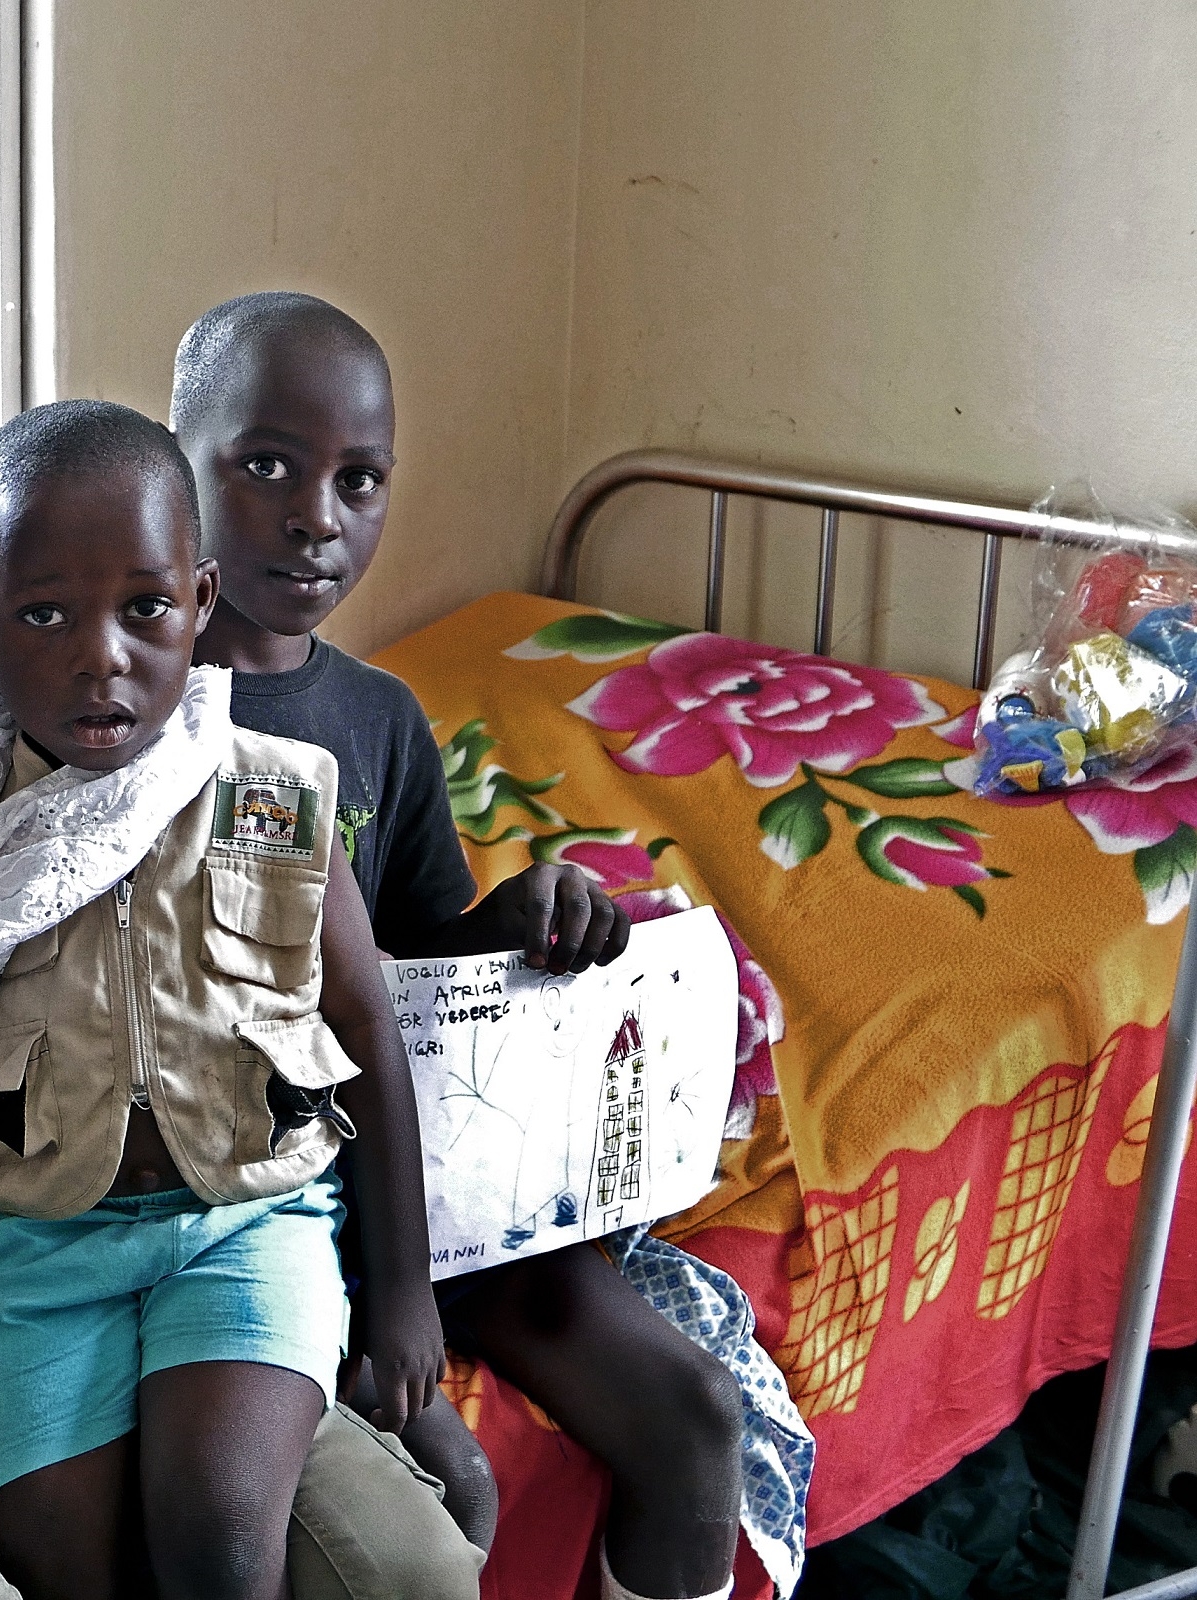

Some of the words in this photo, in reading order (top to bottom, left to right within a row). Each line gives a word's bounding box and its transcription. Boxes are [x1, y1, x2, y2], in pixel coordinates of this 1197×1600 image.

[396, 964, 458, 984] VOGLIO
[391, 989, 410, 1005] IN
[404, 1040, 444, 1058] IGRI
[431, 1242, 485, 1264] VANNI
